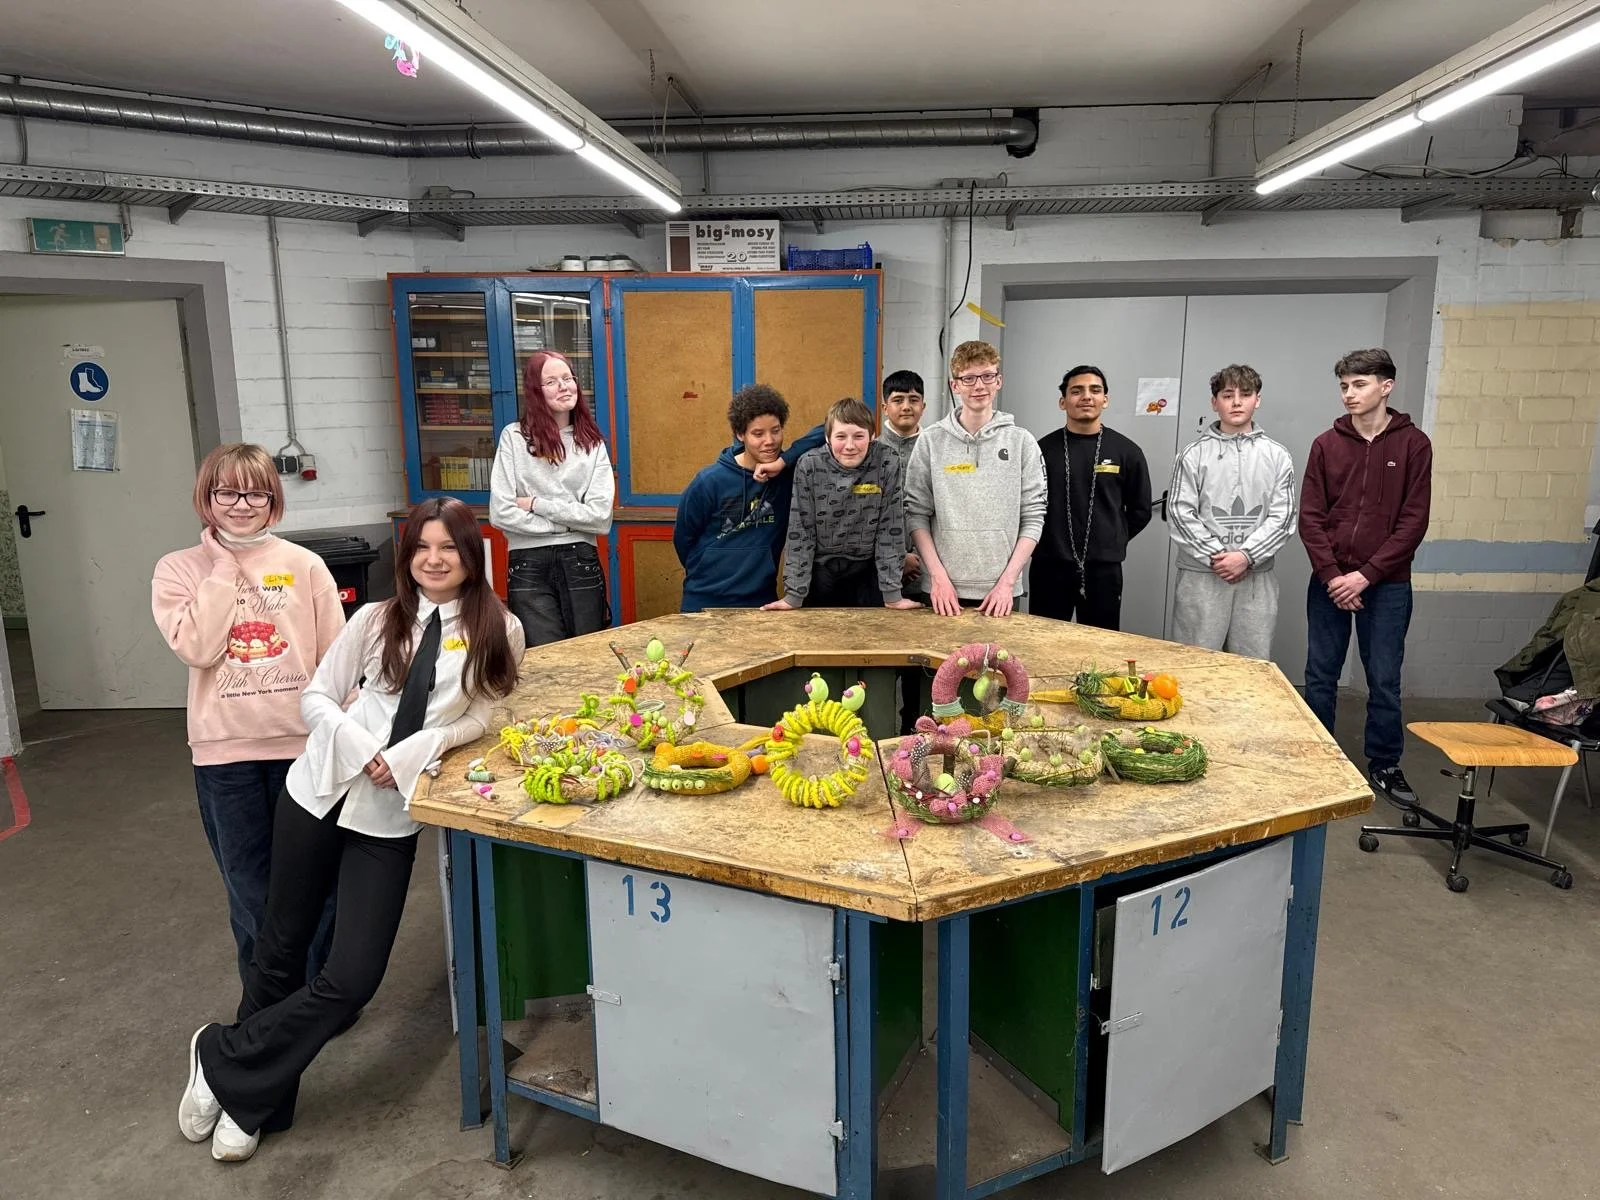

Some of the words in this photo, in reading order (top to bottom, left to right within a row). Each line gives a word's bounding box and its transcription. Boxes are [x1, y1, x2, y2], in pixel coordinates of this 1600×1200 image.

[727, 252, 747, 262] 20
[262, 584, 284, 593] way
[236, 598, 246, 606] to
[247, 592, 288, 614] Wake
[215, 667, 252, 691] With
[256, 666, 307, 686] Cherries
[622, 874, 671, 923] 13
[1151, 887, 1190, 936] 12
